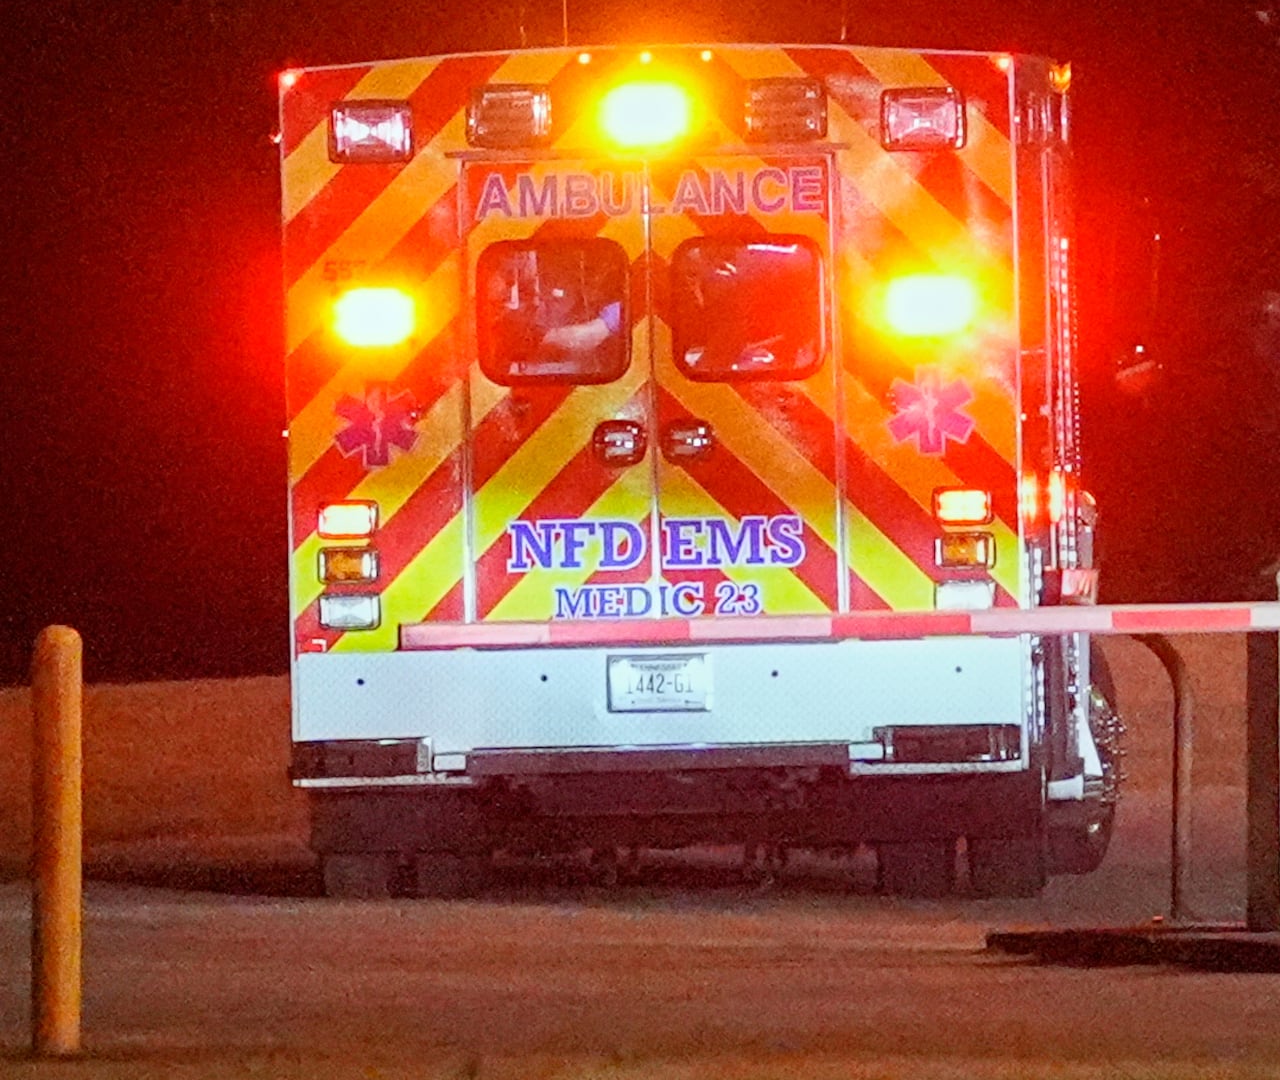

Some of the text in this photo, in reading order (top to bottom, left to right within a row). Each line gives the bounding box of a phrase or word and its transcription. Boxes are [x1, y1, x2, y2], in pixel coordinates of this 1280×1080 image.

[476, 166, 825, 218] AMBULANCE
[508, 516, 805, 571] NFD EMS
[554, 582, 762, 618] MEDIC 23
